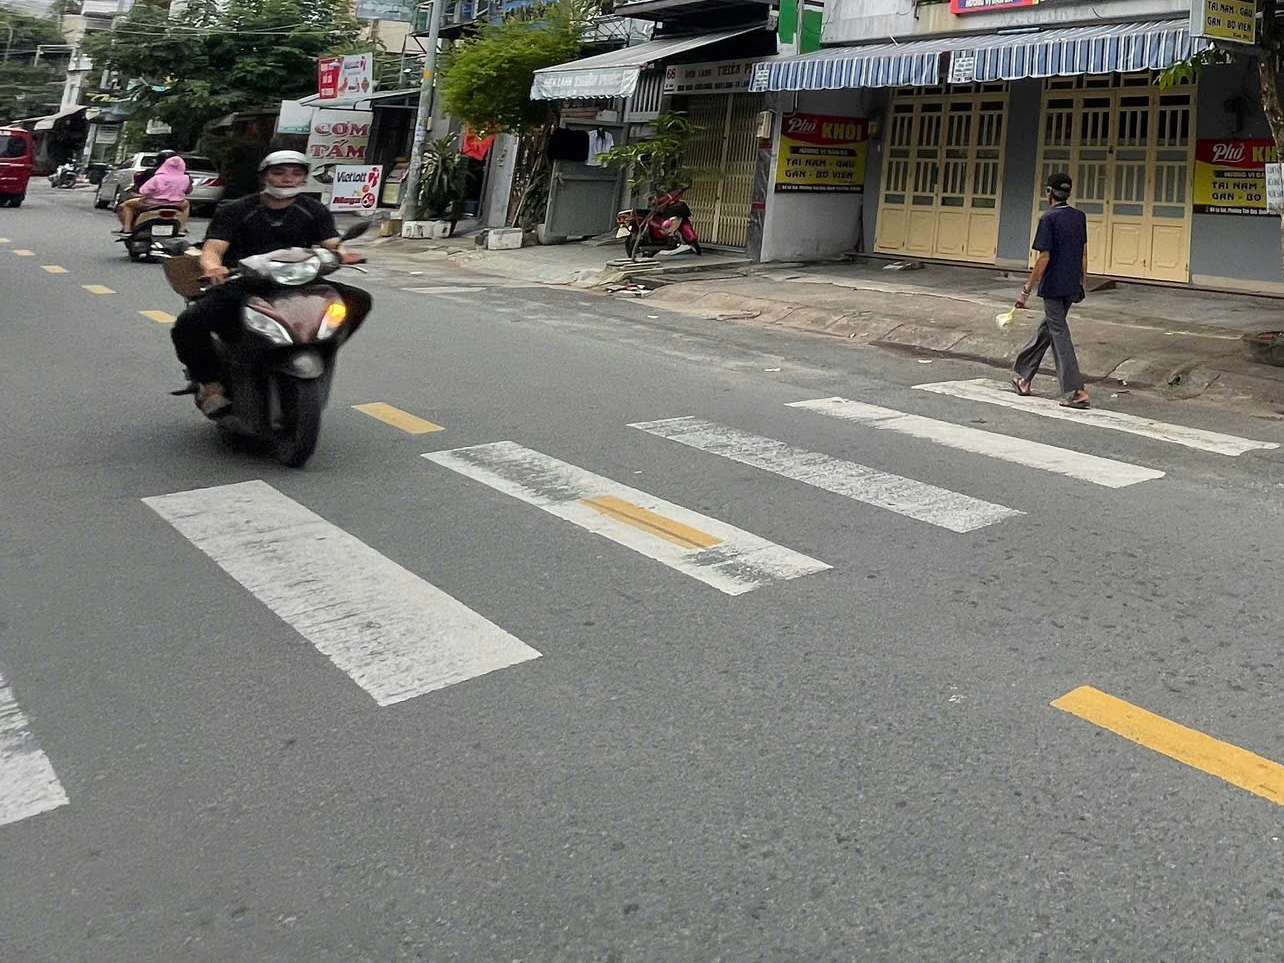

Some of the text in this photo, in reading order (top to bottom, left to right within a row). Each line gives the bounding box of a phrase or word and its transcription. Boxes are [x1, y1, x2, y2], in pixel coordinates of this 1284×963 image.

[315, 121, 370, 136] CƠM
[310, 139, 366, 159] TẤM
[1212, 143, 1246, 163] Phở
[337, 172, 367, 183] Vietlott
